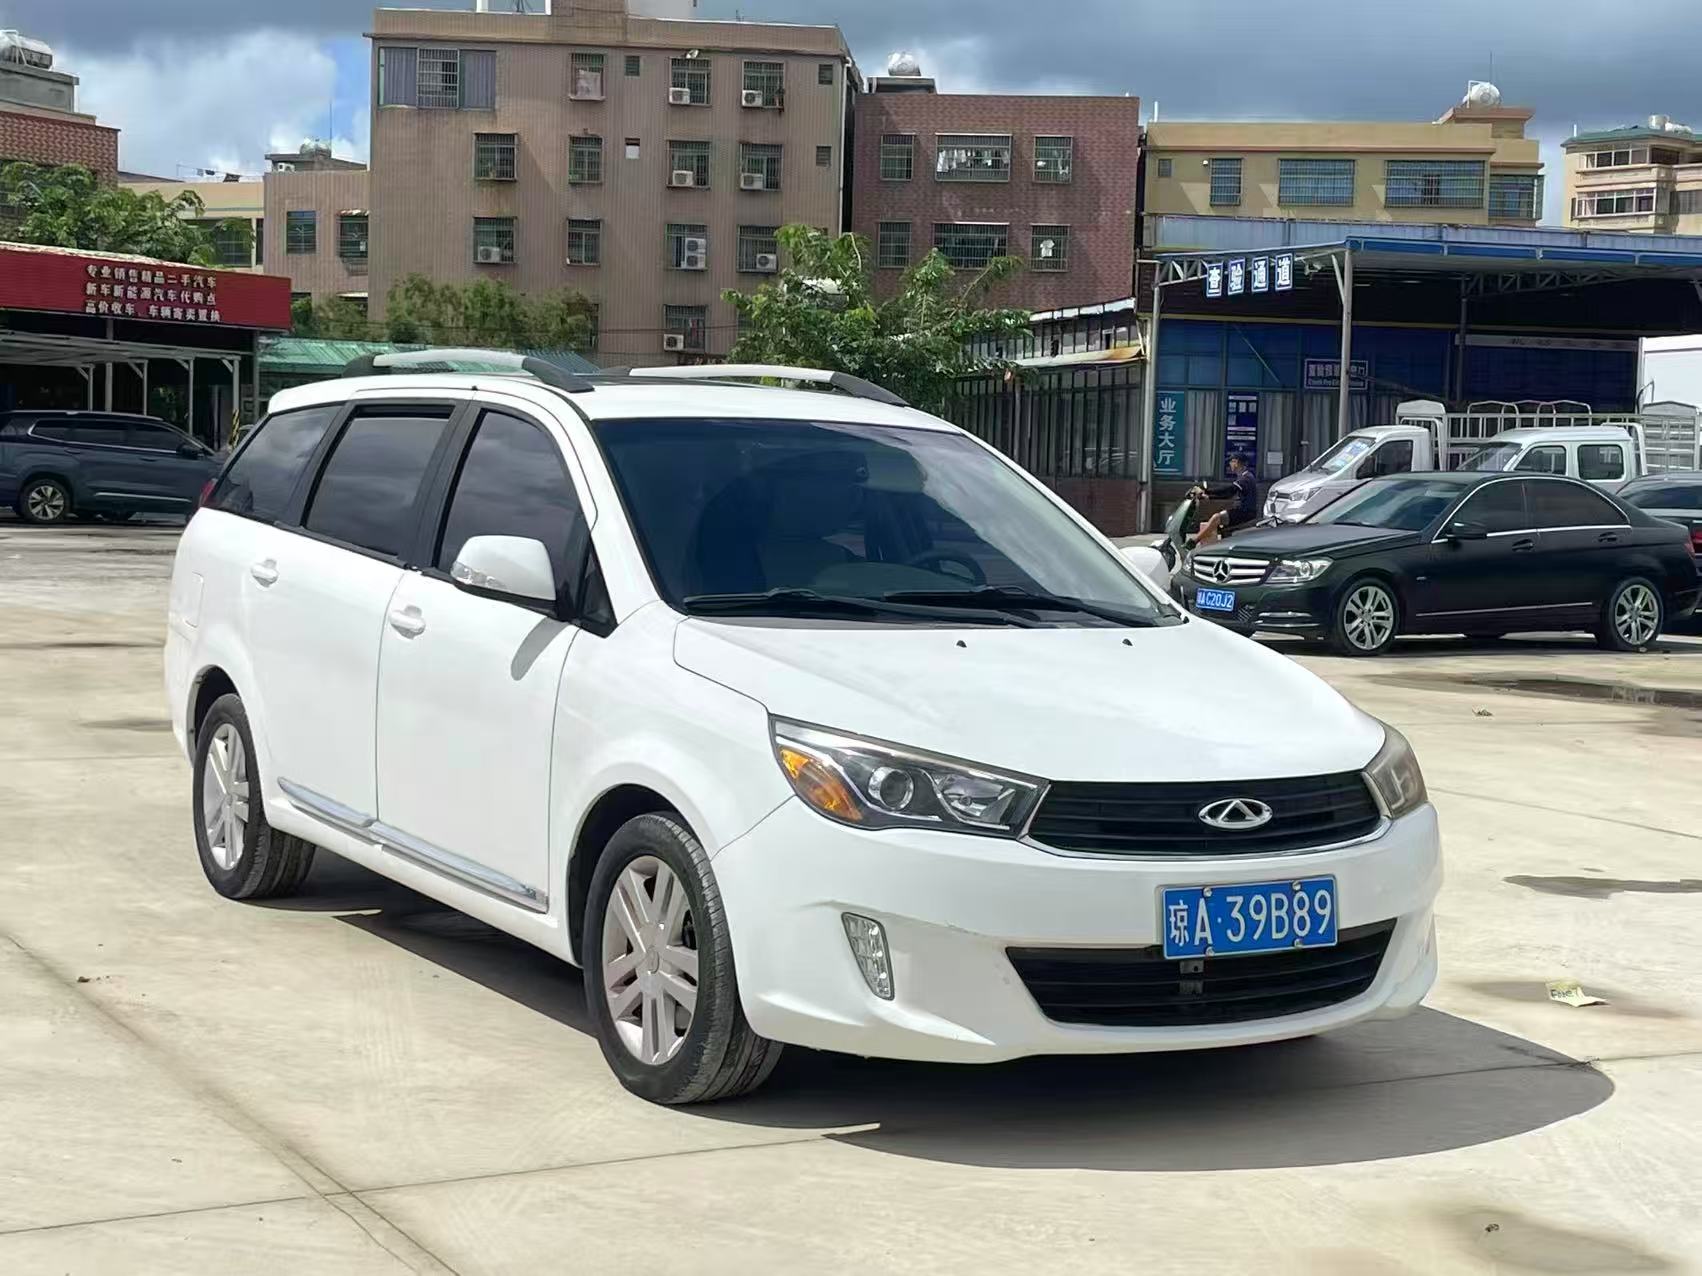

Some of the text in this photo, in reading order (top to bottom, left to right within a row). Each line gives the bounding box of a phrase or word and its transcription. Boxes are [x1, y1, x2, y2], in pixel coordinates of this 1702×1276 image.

[87, 264, 217, 289] 专业销售精品二手汽车
[1208, 256, 1291, 294] 查验通道
[86, 281, 217, 306] 新车新能源汽车代购点
[1157, 396, 1177, 465] 业务大厅
